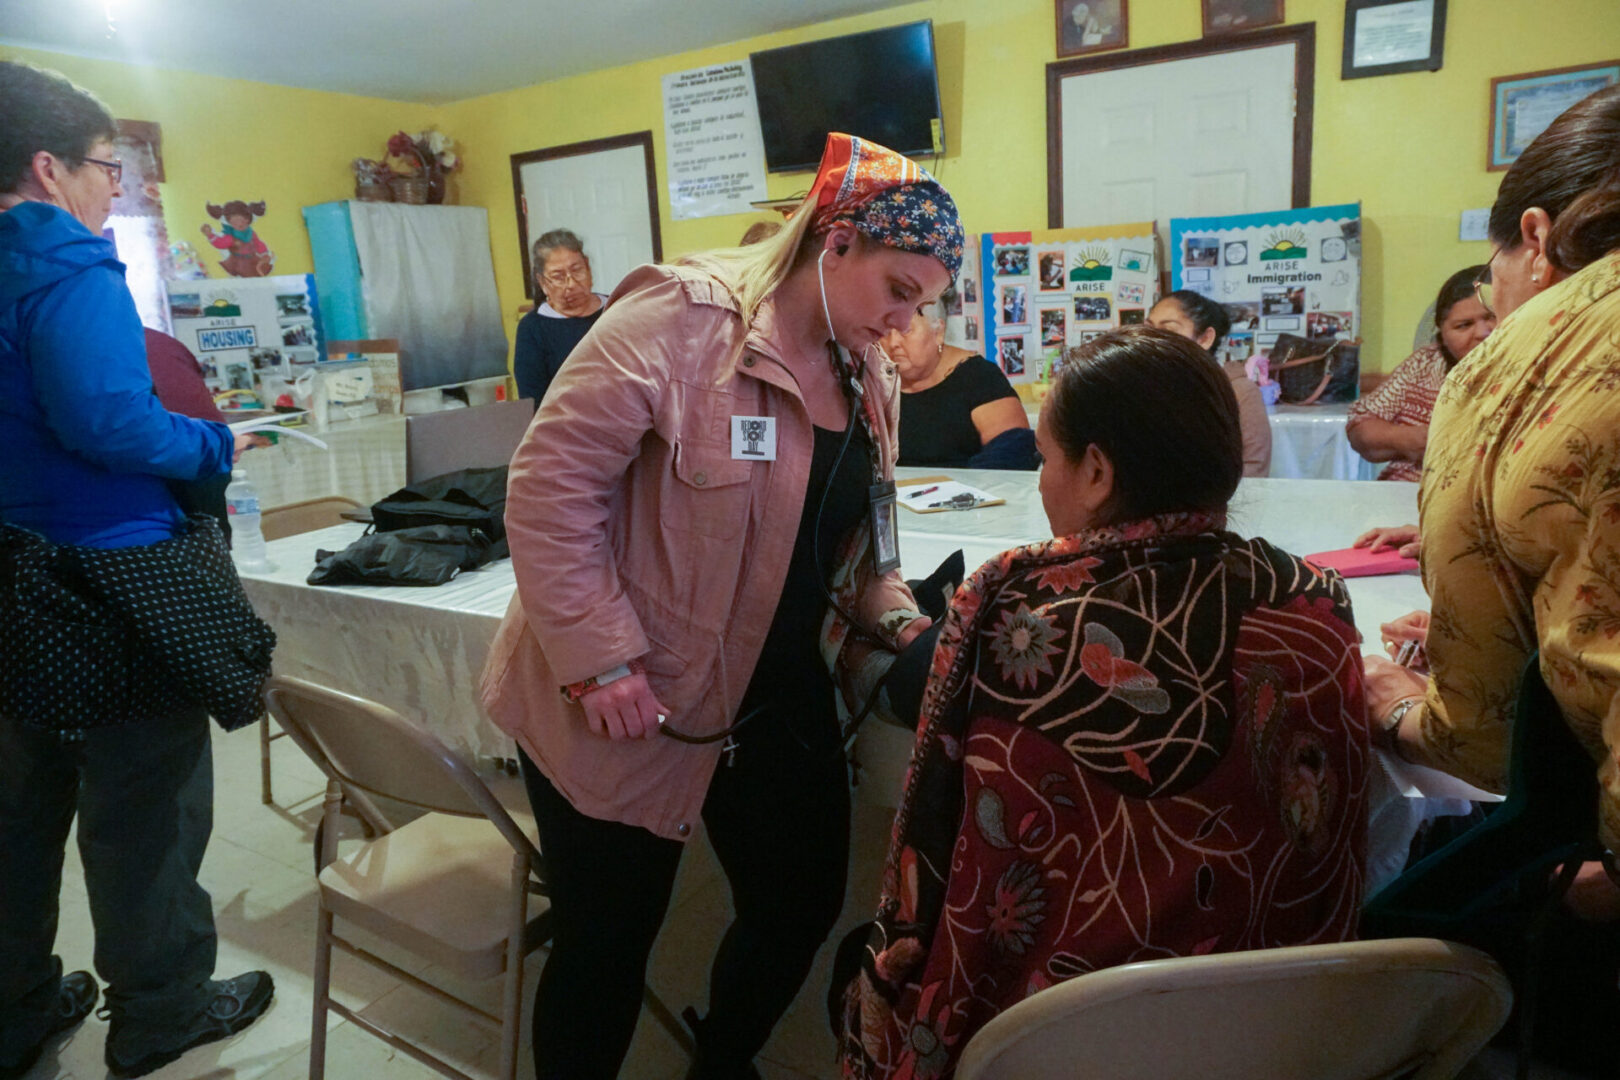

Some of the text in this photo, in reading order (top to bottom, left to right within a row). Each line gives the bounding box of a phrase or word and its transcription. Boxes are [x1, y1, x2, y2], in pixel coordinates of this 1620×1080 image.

[1265, 260, 1299, 271] ARISE
[1247, 271, 1322, 285] Immigration
[1075, 282, 1105, 292] ARISE
[201, 328, 254, 349] HOUSING
